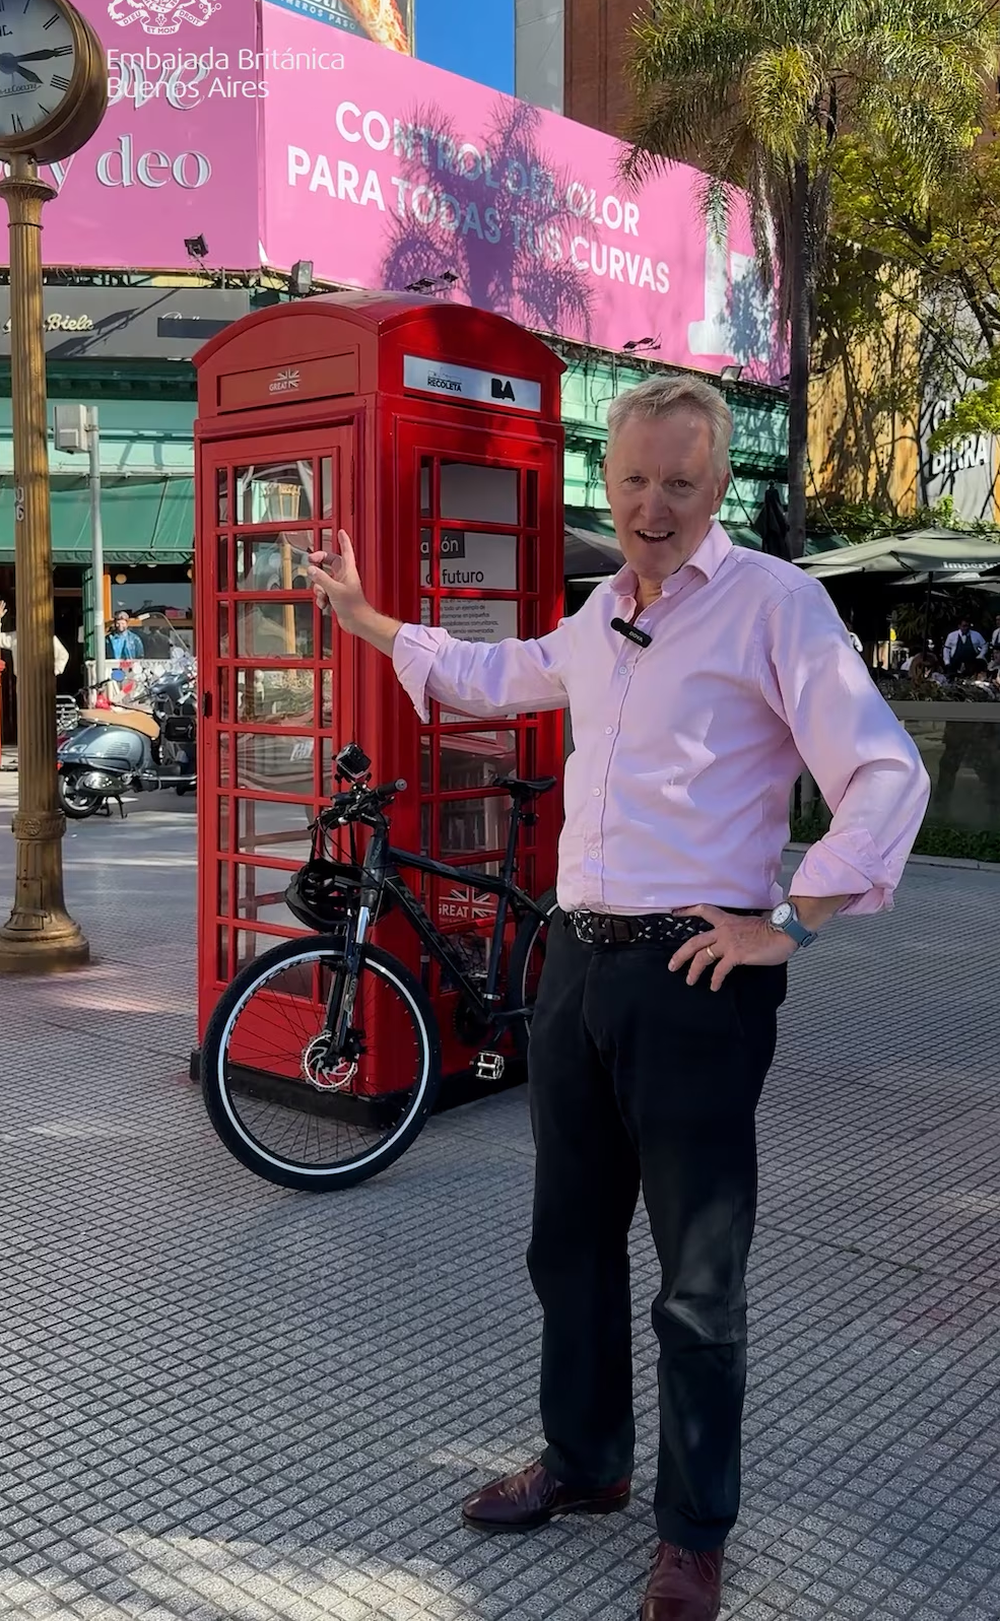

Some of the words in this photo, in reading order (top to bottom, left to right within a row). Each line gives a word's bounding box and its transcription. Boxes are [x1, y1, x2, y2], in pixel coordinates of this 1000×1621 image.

[95, 133, 212, 189] deo
[335, 101, 500, 191] CONTROL
[565, 181, 640, 238] OLOR
[286, 145, 386, 212] PARA
[390, 176, 502, 246] TODAS
[510, 213, 564, 263] TUS
[570, 235, 671, 295] CURVAS
[268, 381, 288, 392] GREAT
[427, 377, 462, 392] RECOLETA
[491, 377, 516, 402] BA
[442, 568, 485, 585] futuro
